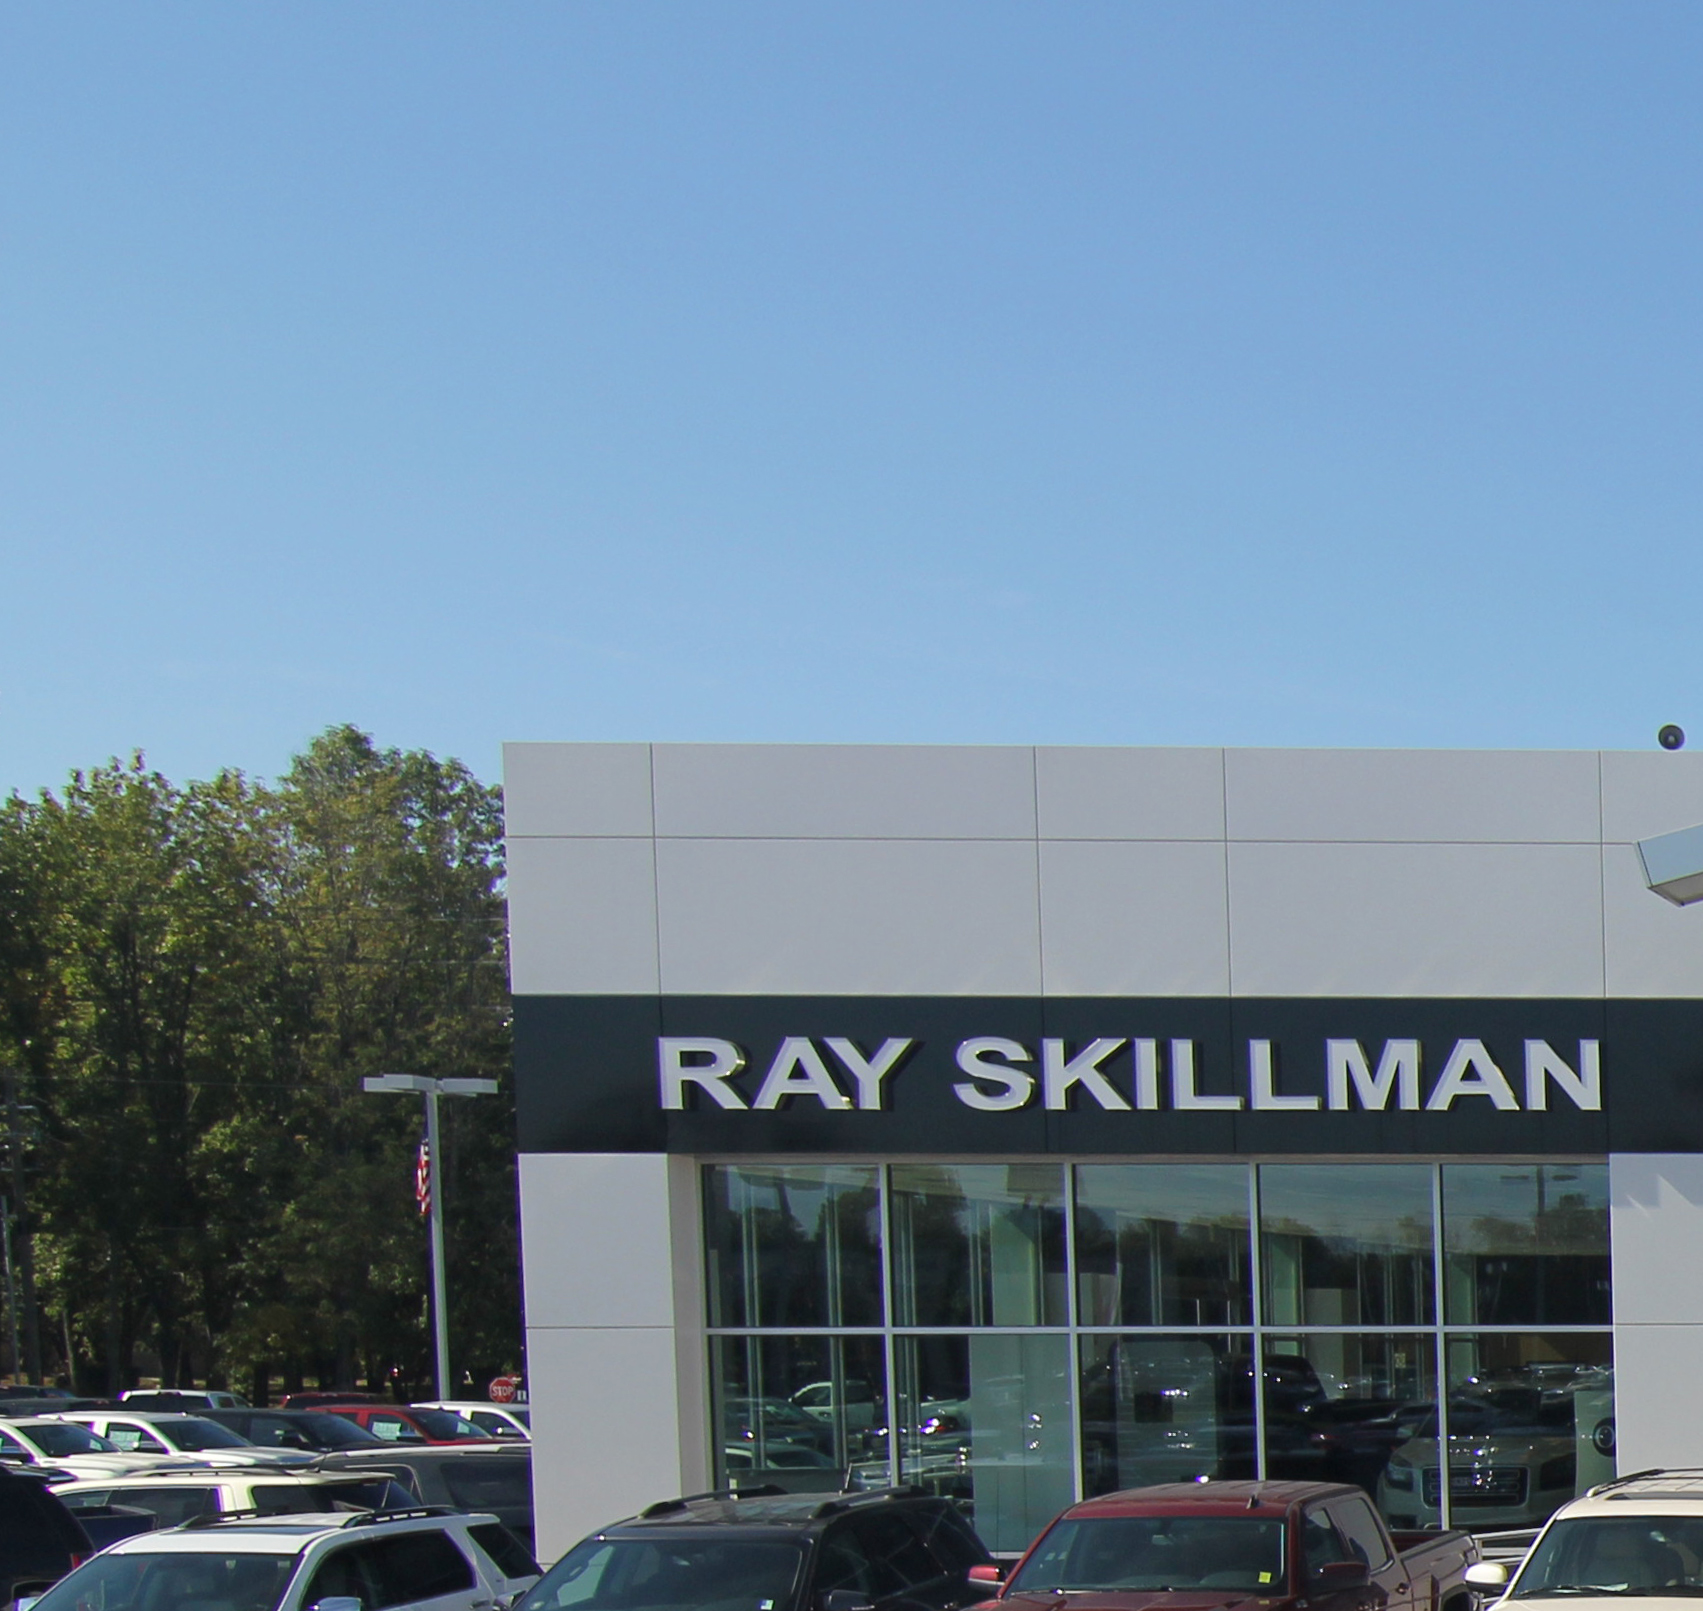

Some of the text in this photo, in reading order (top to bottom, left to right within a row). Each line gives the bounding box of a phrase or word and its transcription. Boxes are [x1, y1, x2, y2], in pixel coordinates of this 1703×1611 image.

[656, 1036, 1602, 1112] RAY SKILLMAN
[491, 1385, 514, 1397] STOP
